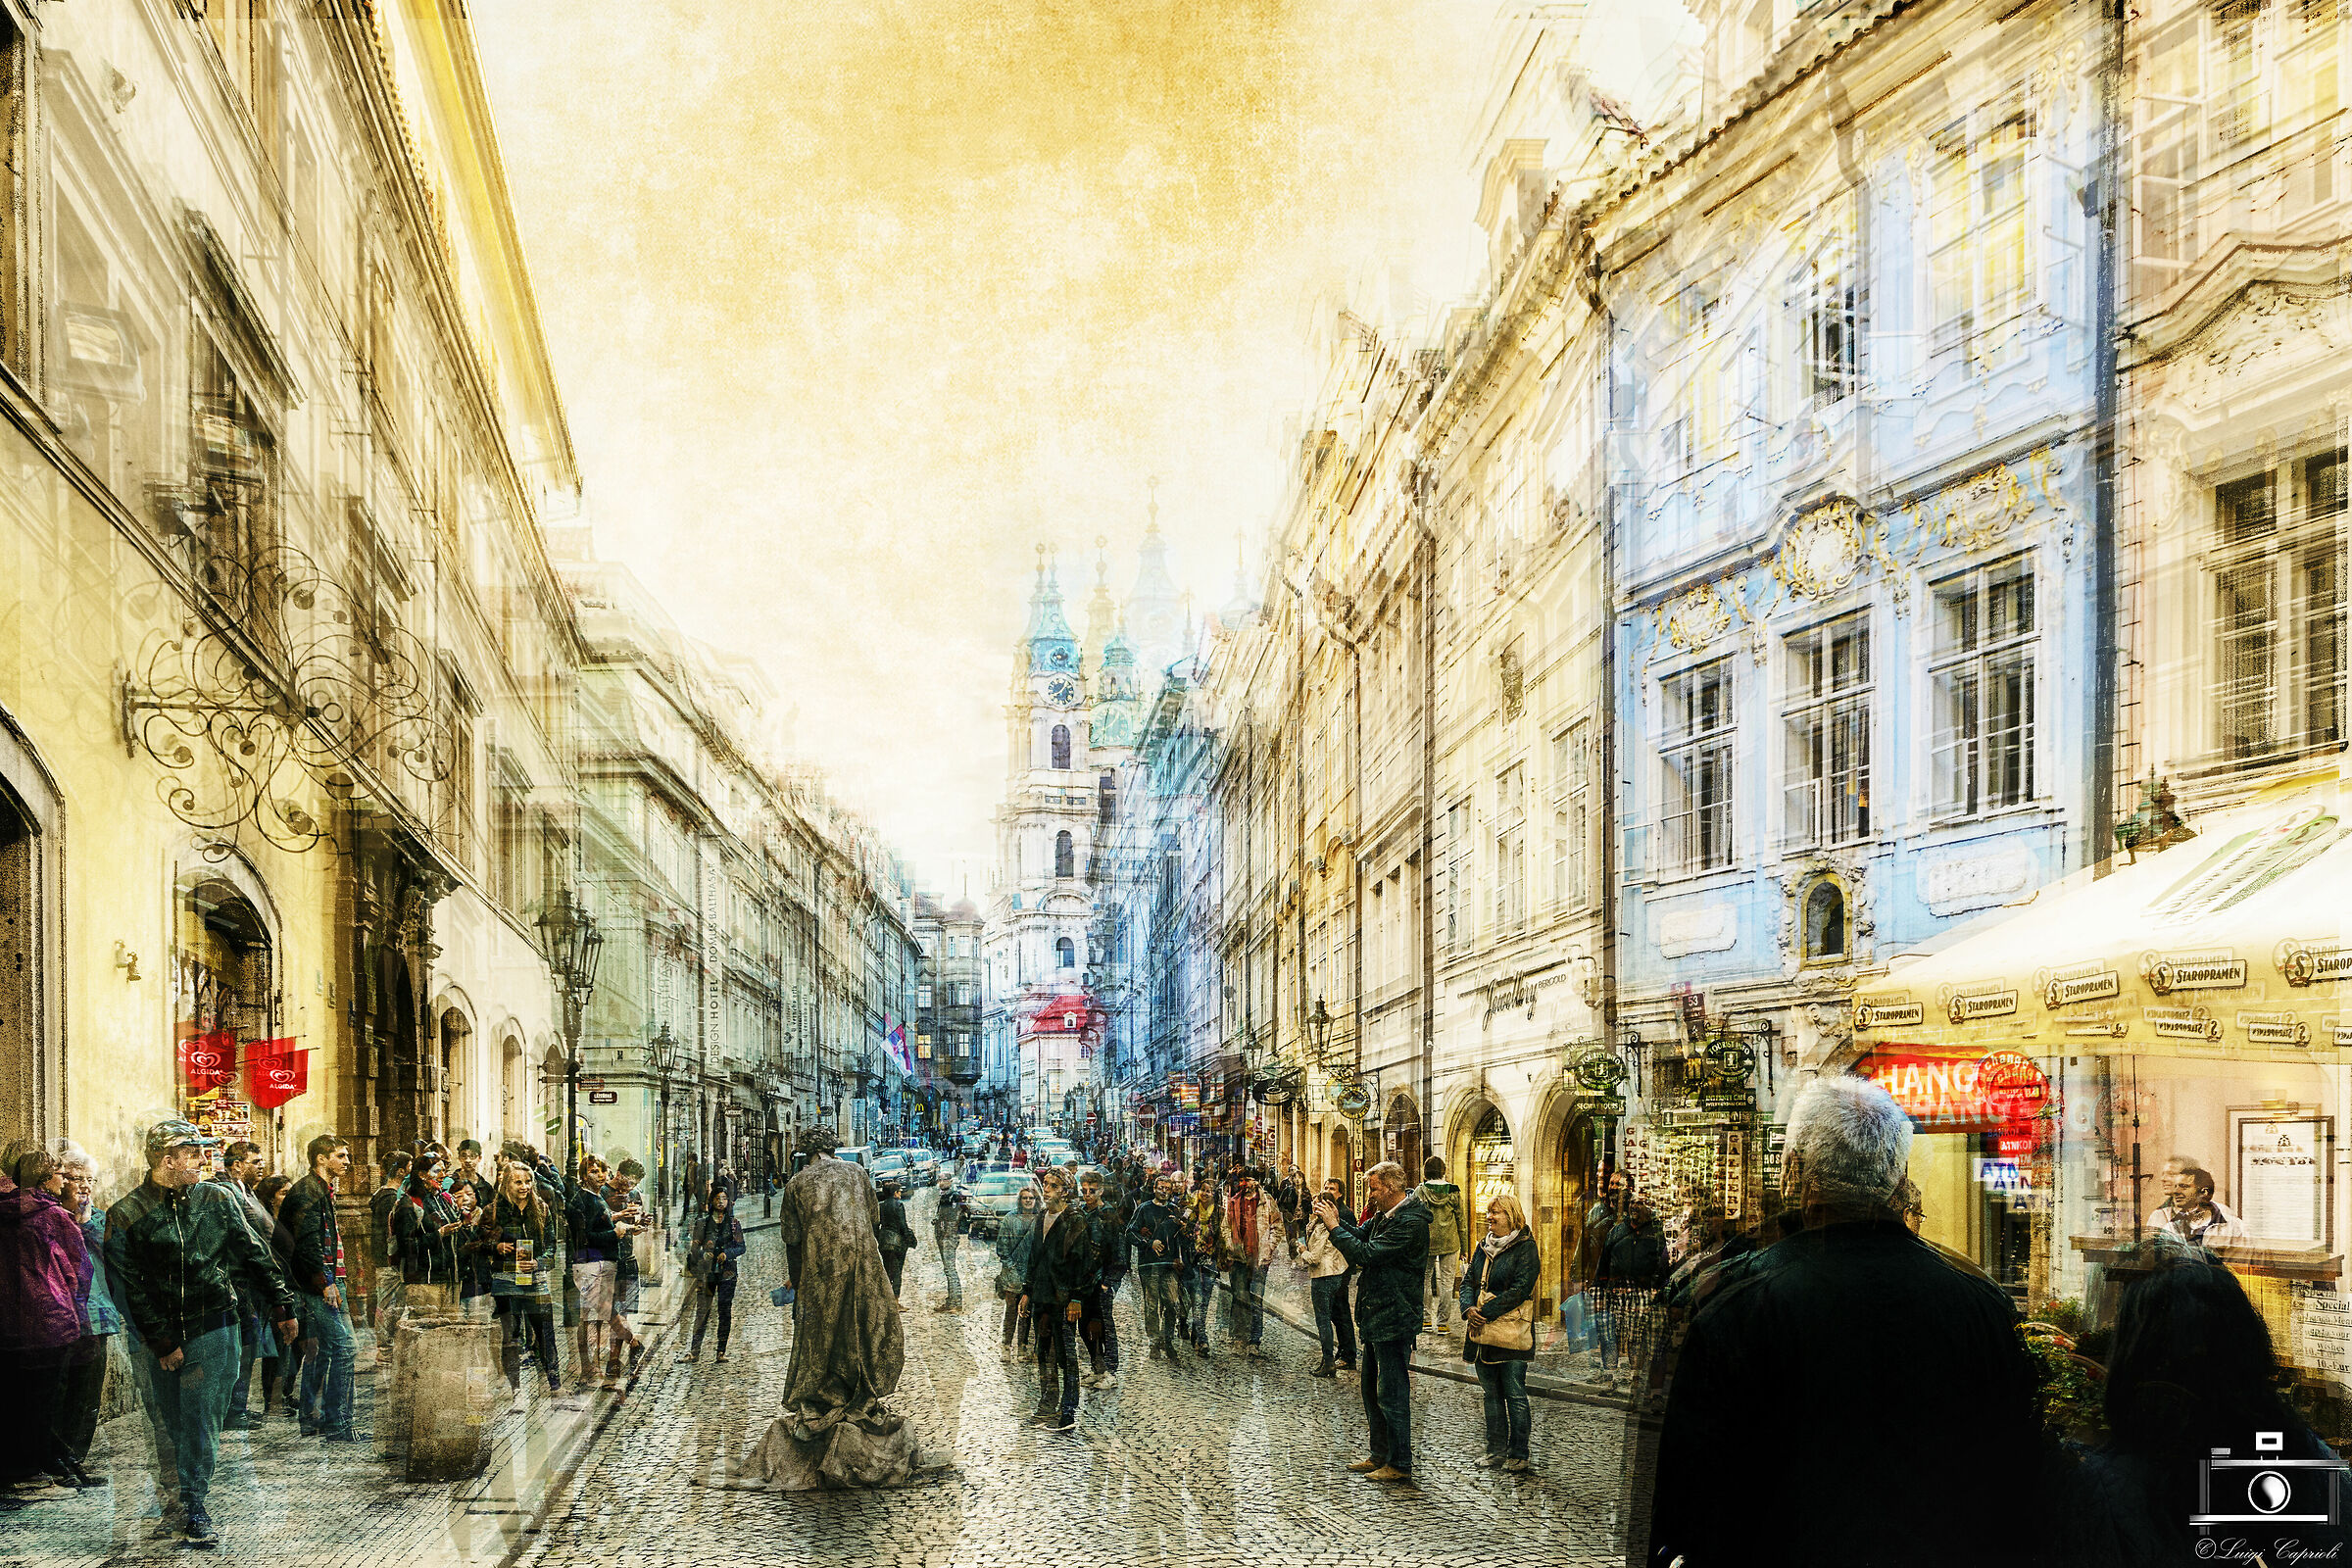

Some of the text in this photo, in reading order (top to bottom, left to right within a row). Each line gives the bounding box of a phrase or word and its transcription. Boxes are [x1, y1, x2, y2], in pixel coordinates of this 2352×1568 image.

[708, 862, 720, 1063] DESIGN HOTEL DOMUS BALTHASAR
[2176, 967, 2241, 984] STAROPRAMEN
[2065, 978, 2114, 998] STAROPRAMEN
[1483, 969, 1539, 1032] Jewellery
[1688, 995, 1698, 1006] 53
[1967, 997, 2014, 1013] STAROPRAMEN
[1874, 1008, 1920, 1022] STAROPRAMEN
[1708, 1040, 1735, 1055] TOURIST
[1764, 1153, 1782, 1164] HOS
[1727, 1135, 1740, 1216] GALLERY
[2316, 1299, 2350, 1311] Special
